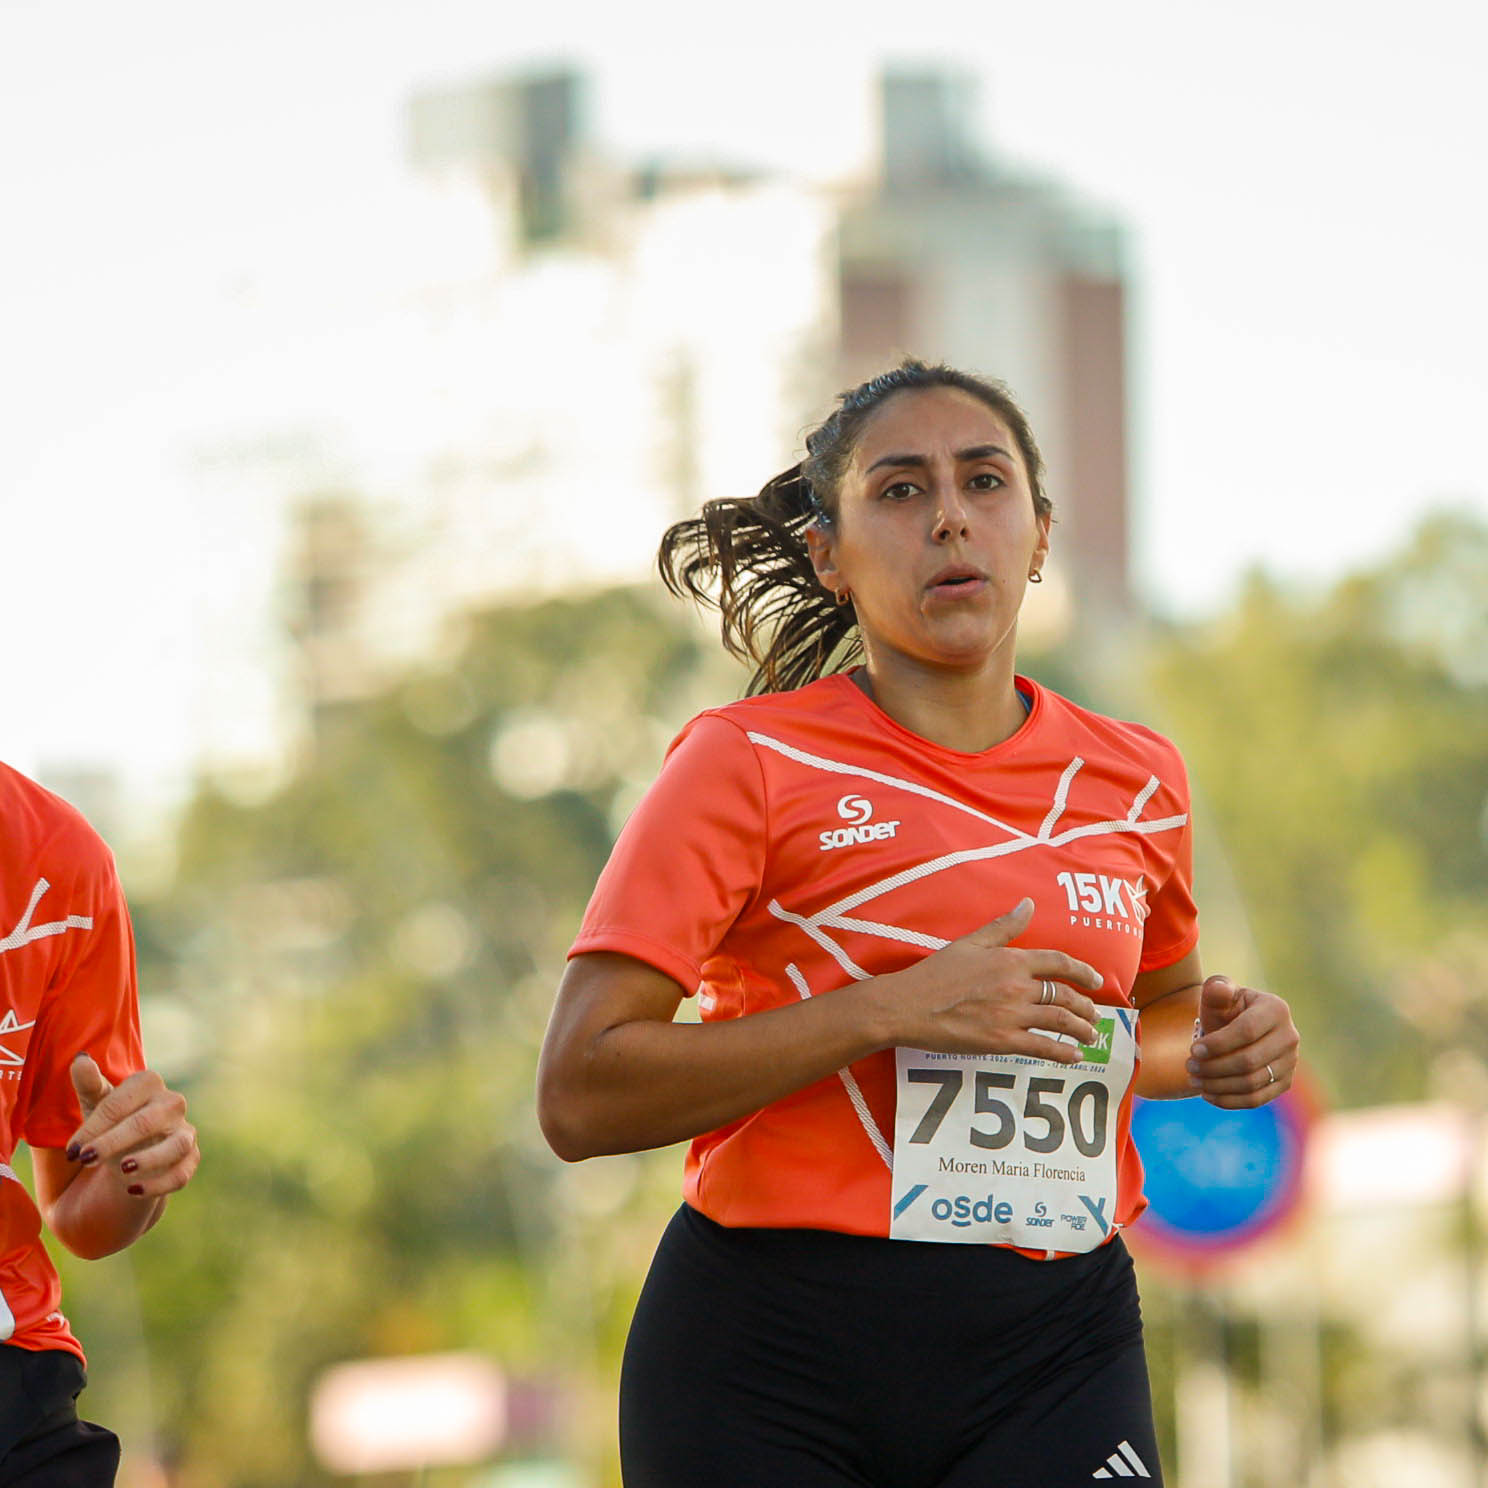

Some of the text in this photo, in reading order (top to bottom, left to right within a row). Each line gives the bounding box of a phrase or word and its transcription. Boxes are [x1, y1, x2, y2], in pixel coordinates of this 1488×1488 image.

[1056, 871, 1129, 919] 15K
[1070, 915, 1131, 935] PUERTO
[907, 1068, 1110, 1158] 7550
[938, 1157, 1086, 1182] Moren Maria Florencia
[931, 1194, 1013, 1227] osde
